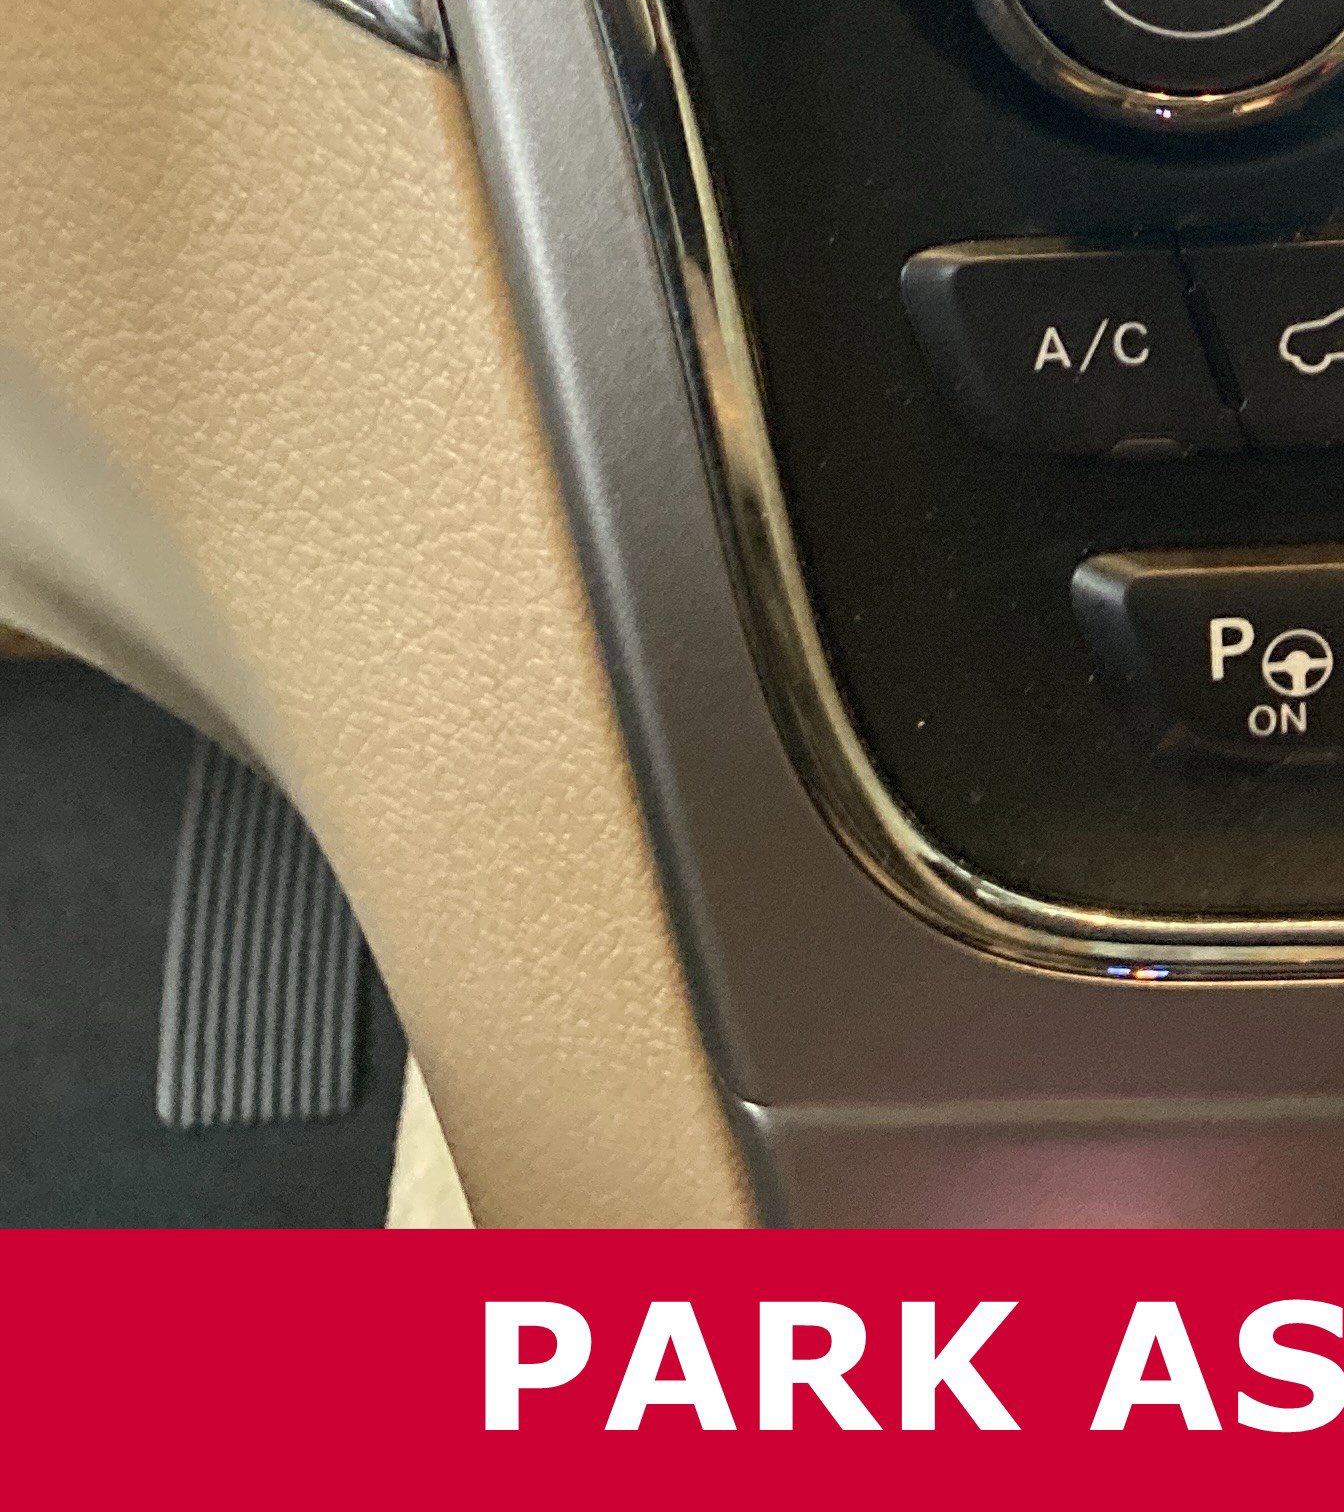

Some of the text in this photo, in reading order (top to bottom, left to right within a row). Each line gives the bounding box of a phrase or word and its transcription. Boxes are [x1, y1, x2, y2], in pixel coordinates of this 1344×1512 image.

[1033, 317, 1150, 373] A/C
[1209, 617, 1255, 681] P
[1247, 702, 1308, 738] ON
